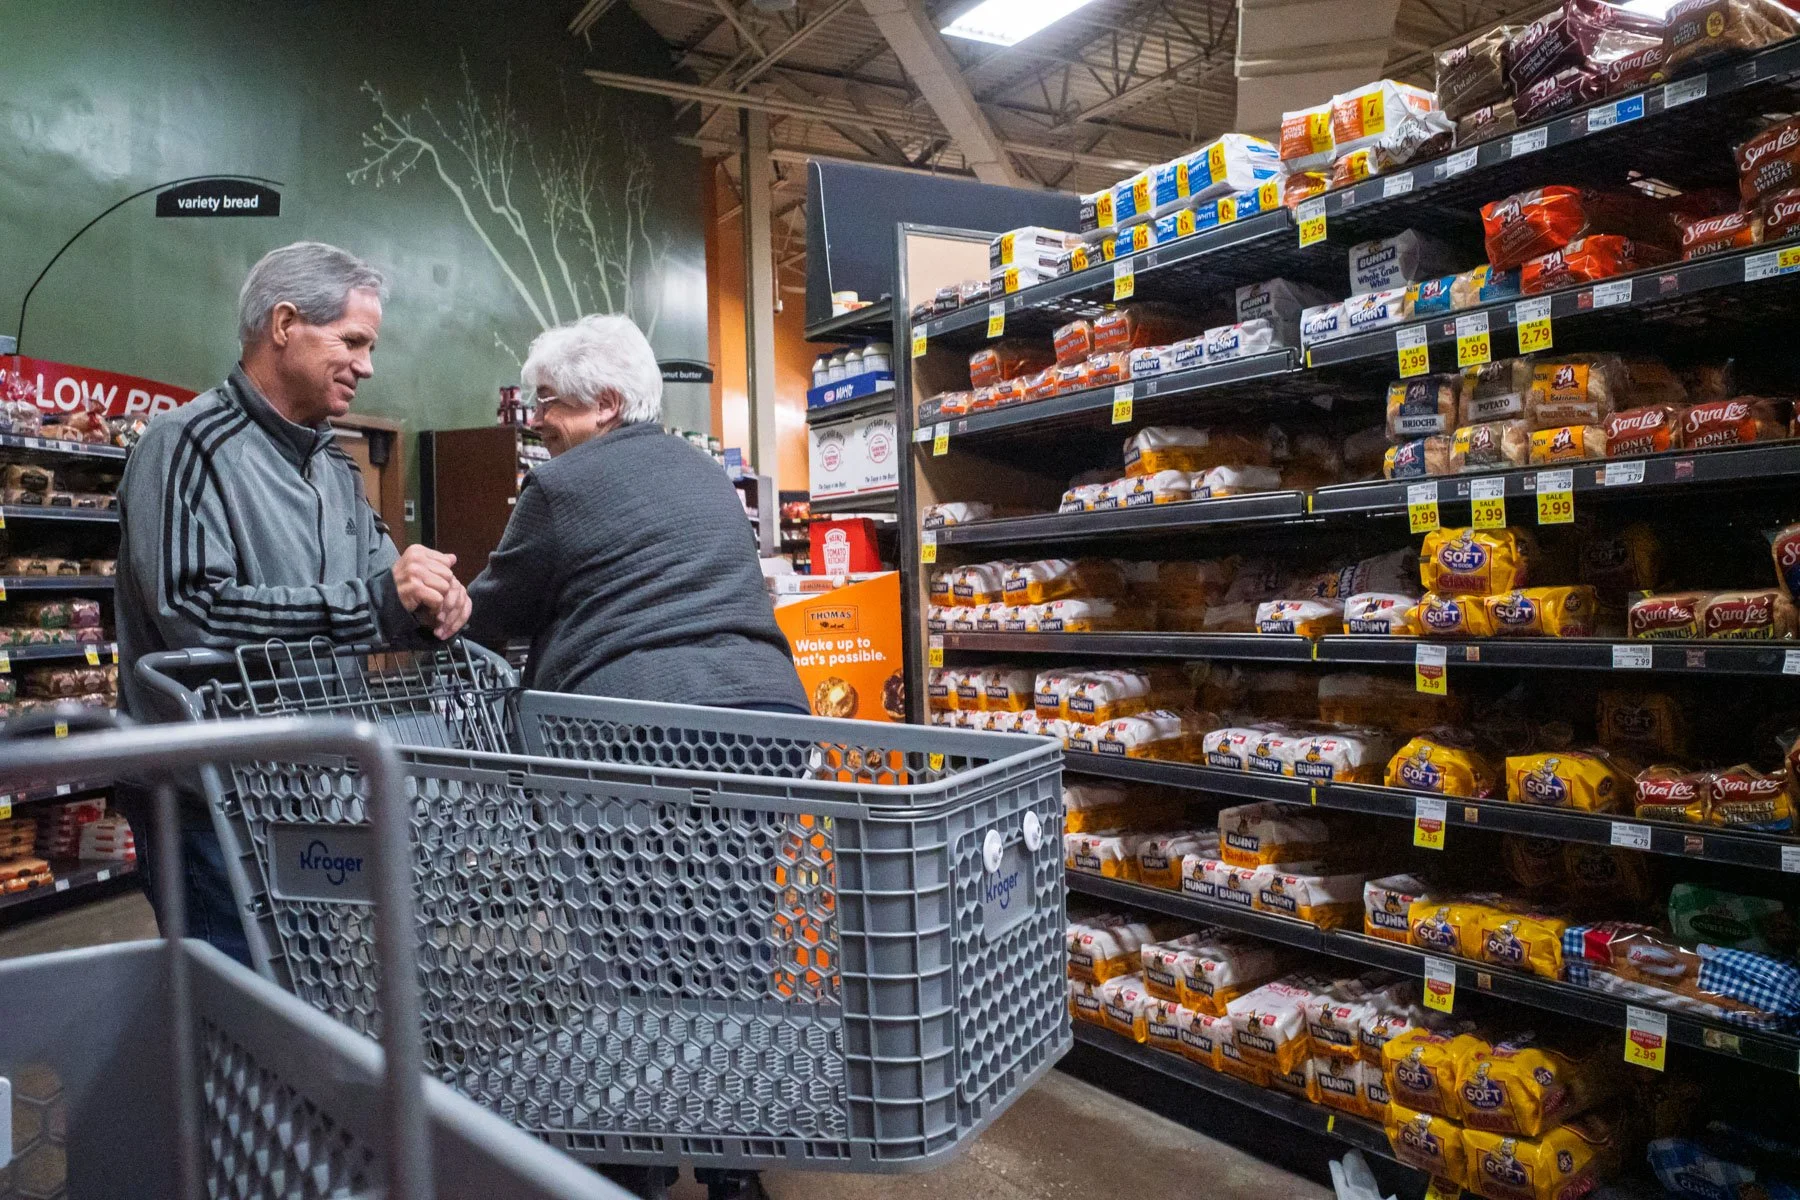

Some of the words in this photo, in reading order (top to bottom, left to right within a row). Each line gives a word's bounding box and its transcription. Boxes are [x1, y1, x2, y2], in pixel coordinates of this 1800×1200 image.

[1608, 59, 1641, 83] Sara
[1640, 50, 1664, 69] Lee
[1453, 72, 1477, 95] Potato
[1367, 98, 1378, 117] 7
[1740, 141, 1776, 171] Sara
[1775, 127, 1800, 153] Lee
[1753, 160, 1793, 187] WHOLE
[1760, 159, 1785, 174] 100%
[1756, 169, 1793, 193] WHEAT
[178, 194, 220, 211] variety
[223, 194, 259, 210] bread
[1197, 211, 1216, 221] WHITE
[1302, 223, 1325, 239] 3.29
[1682, 222, 1718, 245] Sara
[1715, 212, 1745, 234] Lee
[1133, 231, 1148, 246] 35
[1688, 237, 1735, 259] HONEY
[1358, 249, 1394, 268] BUNNY
[1357, 273, 1379, 285] Whole
[1380, 265, 1400, 277] Grain
[1762, 266, 1779, 276] 4.49
[1369, 278, 1391, 288] White
[1616, 293, 1630, 302] 3.79
[1350, 306, 1385, 325] BUNNY
[1304, 318, 1336, 334] BUNNY
[1474, 324, 1488, 332] 4.29
[1526, 320, 1543, 330] SALE
[1465, 336, 1481, 344] SALE
[1521, 327, 1550, 345] 2.79
[1405, 347, 1419, 356] SALE
[1460, 343, 1488, 359] 2.99
[1134, 359, 1159, 372] BUNNY
[1401, 355, 1427, 370] 2.99
[679, 371, 703, 379] butter
[1534, 372, 1548, 381] NEW
[35, 373, 119, 417] LOW
[1114, 406, 1131, 417] 2.89
[1478, 398, 1510, 412] POTATO
[1402, 418, 1437, 428] BRIOCHE
[1607, 416, 1640, 440] Sara
[1639, 410, 1665, 431] Lee
[1685, 409, 1722, 433] Sara
[1721, 402, 1749, 422] Lee
[1456, 437, 1469, 445] NEW
[1532, 438, 1547, 447] NEW
[1613, 435, 1654, 454] HONEY
[1694, 428, 1738, 448] HONEY
[1557, 481, 1572, 489] 4.29
[1627, 473, 1642, 482] 3.79
[1127, 492, 1152, 505] BUNNY
[1490, 489, 1503, 497] 4.29
[1545, 493, 1563, 501] SALE
[1061, 501, 1082, 512] BUNNY
[1095, 498, 1116, 510] BUNNY
[1415, 504, 1430, 512] SALE
[1480, 500, 1496, 508] SALE
[1540, 501, 1571, 516] 2.99
[1411, 511, 1437, 526] 2.99
[1474, 507, 1503, 522] 2.99
[827, 547, 847, 557] TOMATO
[1443, 551, 1482, 564] SOFT
[1006, 579, 1026, 592] BUNNY
[1427, 610, 1459, 623] SOFT
[1495, 606, 1533, 619] SOFT
[1634, 607, 1668, 630] Sara
[1708, 607, 1744, 629] Sara
[1743, 604, 1768, 625] Lee
[1005, 621, 1025, 631] BUNNY
[1039, 620, 1063, 631] BUNNY
[1260, 620, 1293, 633] BUNNY
[1350, 620, 1387, 634] BUNNY
[795, 637, 833, 652] Wake
[837, 641, 854, 652] up
[857, 637, 871, 648] to
[794, 653, 825, 667] hat's
[829, 649, 887, 667] possible.
[1634, 658, 1650, 667] 2.99
[1422, 679, 1440, 690] 2.59
[1036, 696, 1059, 706] BUNNY
[1070, 701, 1094, 712] BUNNY
[1098, 742, 1124, 755] BUNNY
[1209, 755, 1241, 769] BUNNY
[1297, 763, 1331, 777] BUNNY
[1403, 766, 1434, 781] SOFT
[1526, 781, 1562, 797] SOFT
[1636, 780, 1668, 800] Sara
[1667, 782, 1696, 800] Lee
[1713, 778, 1748, 800] Sara
[1228, 834, 1259, 850] BUNNY
[1420, 833, 1438, 843] 2.59
[1633, 838, 1649, 847] 4.79
[300, 840, 363, 886] Kroger
[1076, 856, 1100, 869] BUNNY
[985, 868, 1019, 909] Kroger
[1184, 880, 1215, 895] BUNNY
[1219, 889, 1251, 905] BUNNY
[1262, 893, 1295, 910] BUNNY
[1419, 927, 1452, 943] SOFT
[1488, 940, 1521, 959] SOFT
[1077, 995, 1099, 1009] BUNNY
[1429, 994, 1447, 1006] 2.59
[1150, 1023, 1177, 1038] BUNNY
[1183, 1031, 1211, 1051] BUNNY
[1239, 1030, 1275, 1051] BUNNY
[1634, 1047, 1657, 1062] 2.99
[1399, 1068, 1431, 1085] SOFT
[1321, 1076, 1354, 1093] BUNNY
[1466, 1087, 1501, 1101] SOFT
[1403, 1130, 1437, 1155] SOFT
[1485, 1162, 1524, 1182] SOFT
